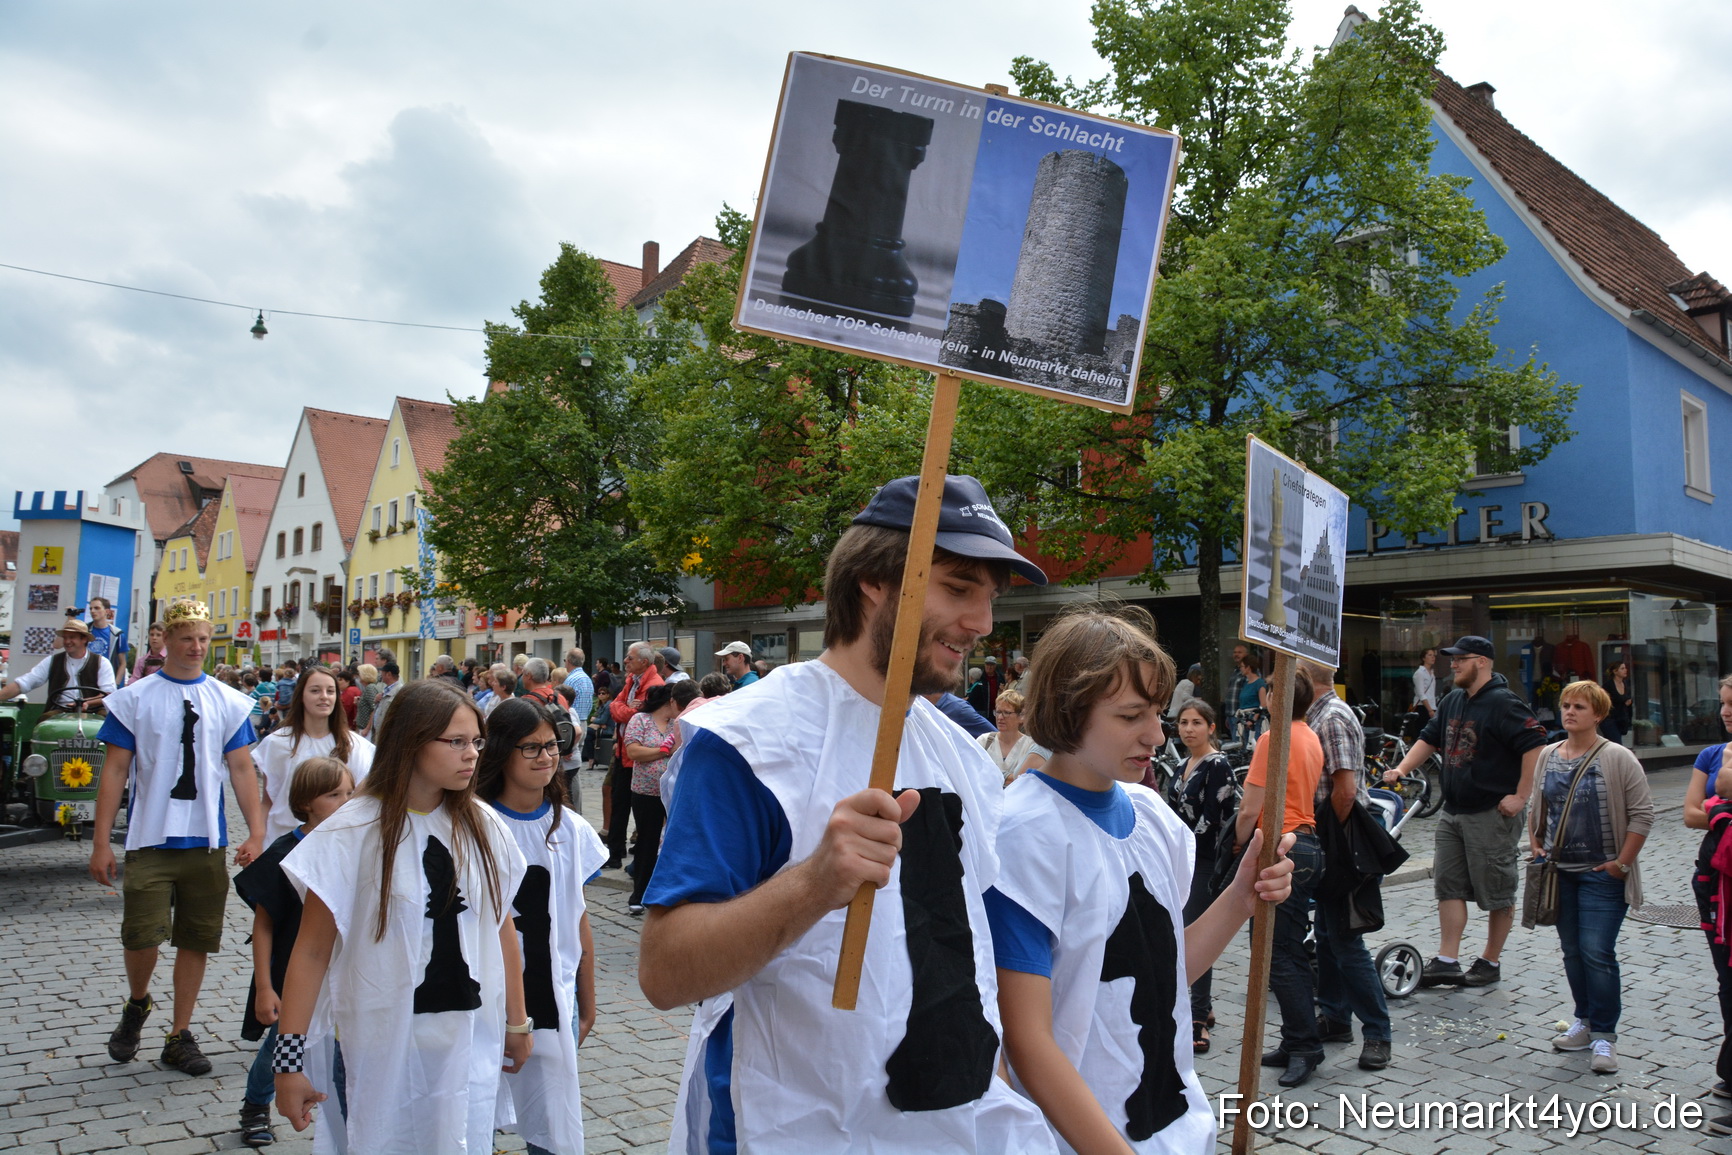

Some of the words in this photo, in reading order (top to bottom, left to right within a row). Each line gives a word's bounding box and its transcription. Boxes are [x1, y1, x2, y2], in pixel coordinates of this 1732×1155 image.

[851, 75, 893, 99] Der
[899, 85, 955, 114] Turm
[959, 98, 982, 120] in
[986, 105, 1024, 129] der
[1028, 114, 1125, 153] Schlacht
[753, 297, 832, 324] Deutscher
[833, 314, 970, 354] TOP-Schachverein
[980, 345, 996, 360] in
[998, 348, 1070, 376] Neumarkt
[1071, 365, 1124, 388] daheim
[1282, 472, 1327, 509] Chefstrategen
[1248, 616, 1270, 631] Deutscher
[58, 739, 99, 748] FENDT
